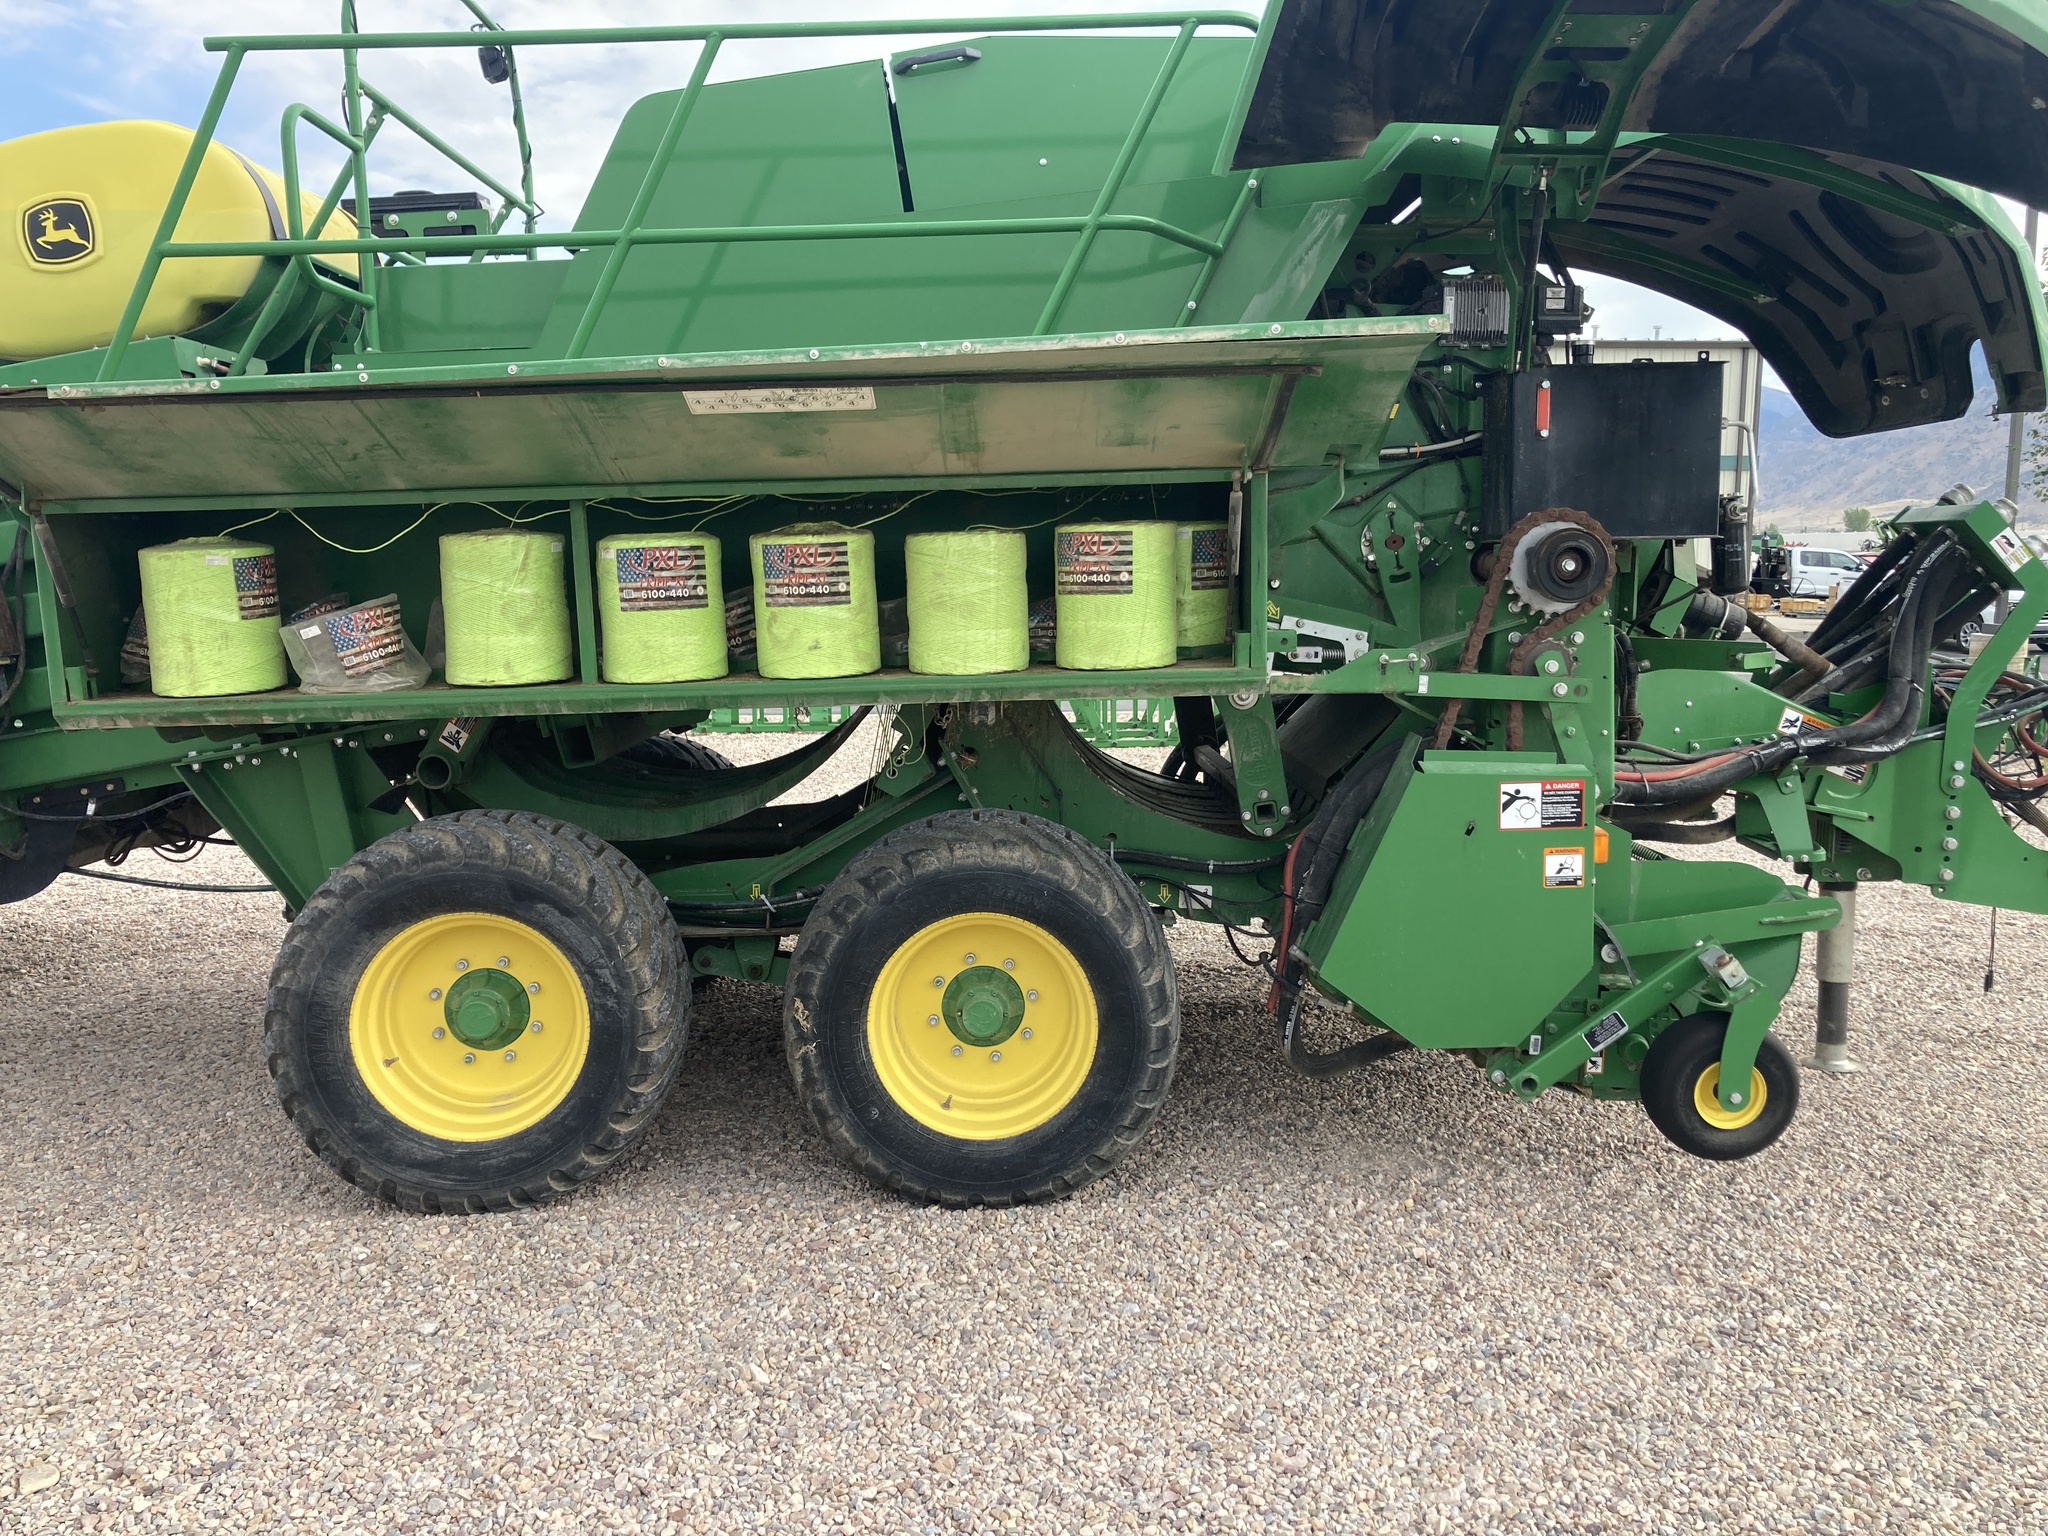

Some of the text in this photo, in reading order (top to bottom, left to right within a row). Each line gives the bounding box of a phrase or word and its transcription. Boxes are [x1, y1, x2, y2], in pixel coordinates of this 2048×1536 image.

[1071, 532, 1108, 554] PXL
[642, 547, 686, 570] PXL
[783, 545, 826, 566] PXL
[1069, 573, 1111, 583] 6100-440
[641, 588, 690, 599] 6100-440
[783, 585, 830, 595] 6100-440
[352, 606, 391, 633] PXL
